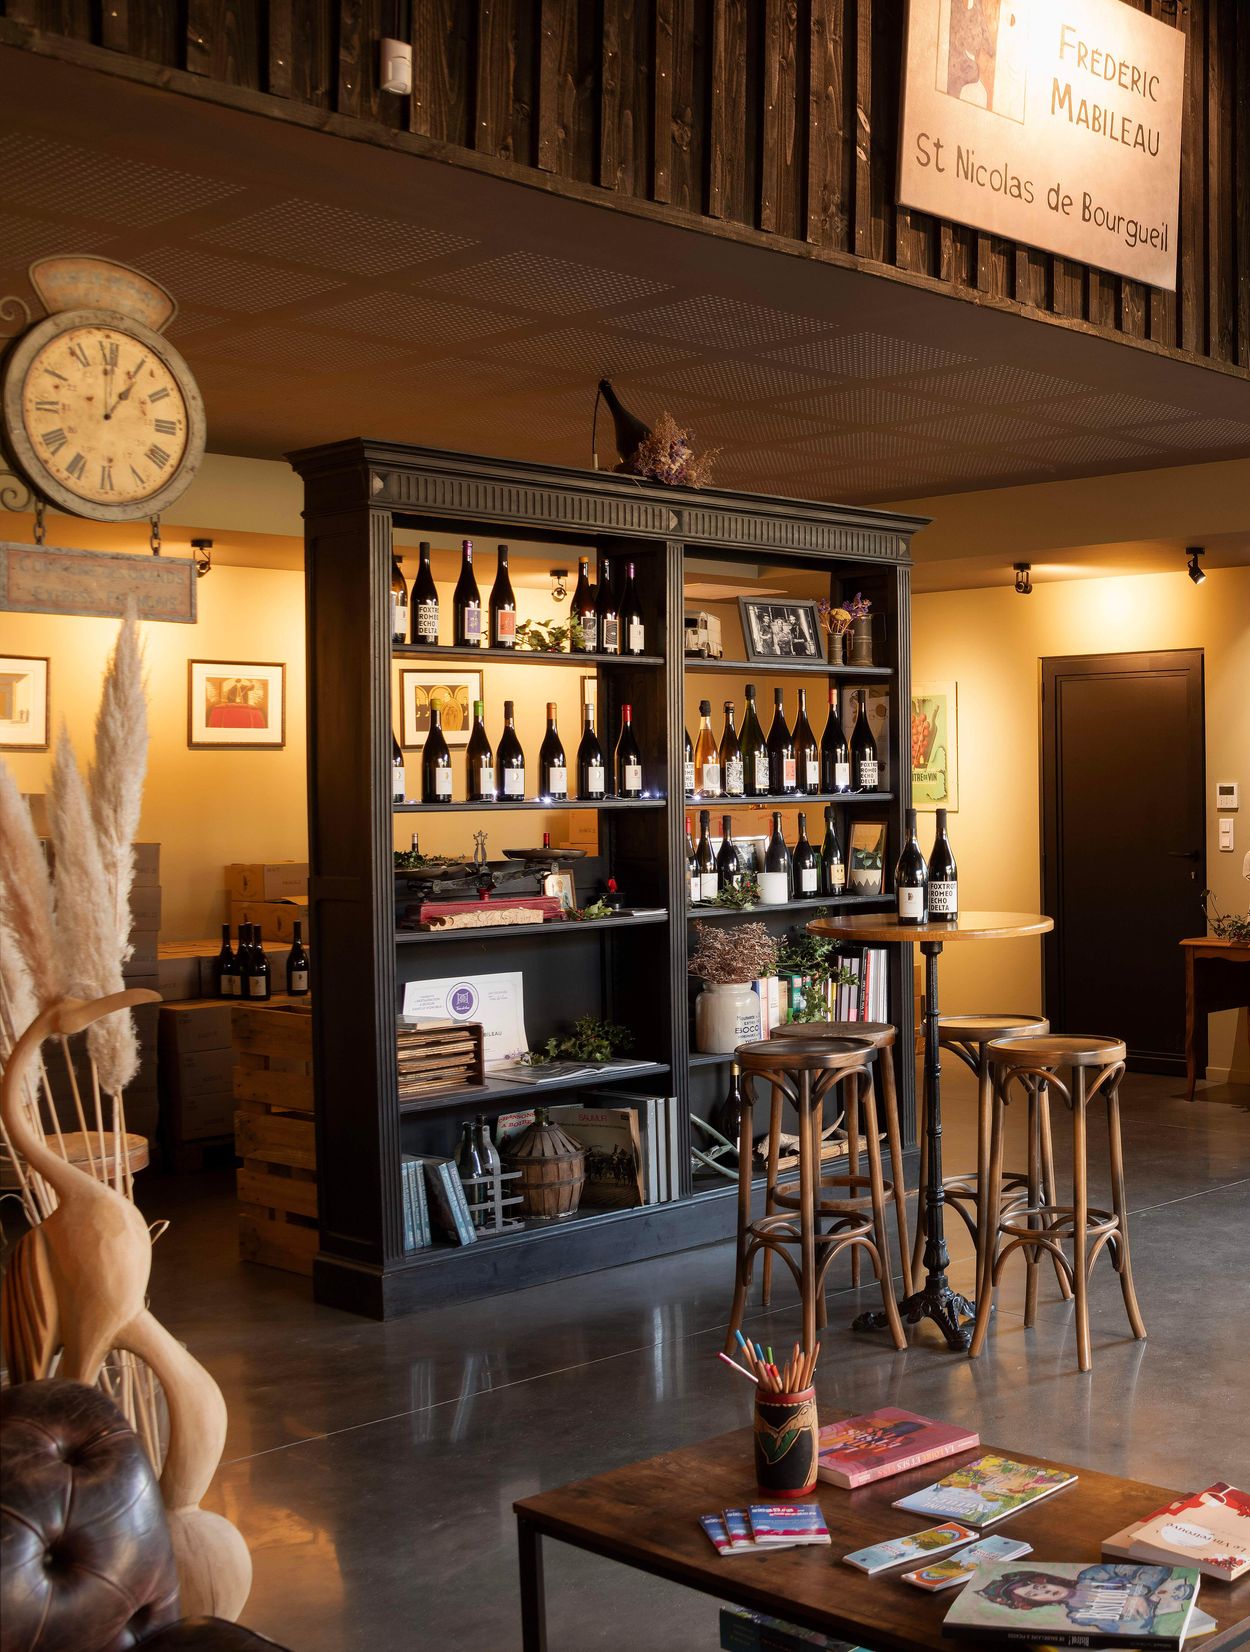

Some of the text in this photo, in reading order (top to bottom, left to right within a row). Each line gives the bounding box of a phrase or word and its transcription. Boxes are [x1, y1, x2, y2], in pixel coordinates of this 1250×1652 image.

[1059, 24, 1160, 102] FRÉDÉRIC
[1051, 78, 1160, 157] MABILEAU
[916, 132, 1168, 252] St Nicolas de Bourgueil
